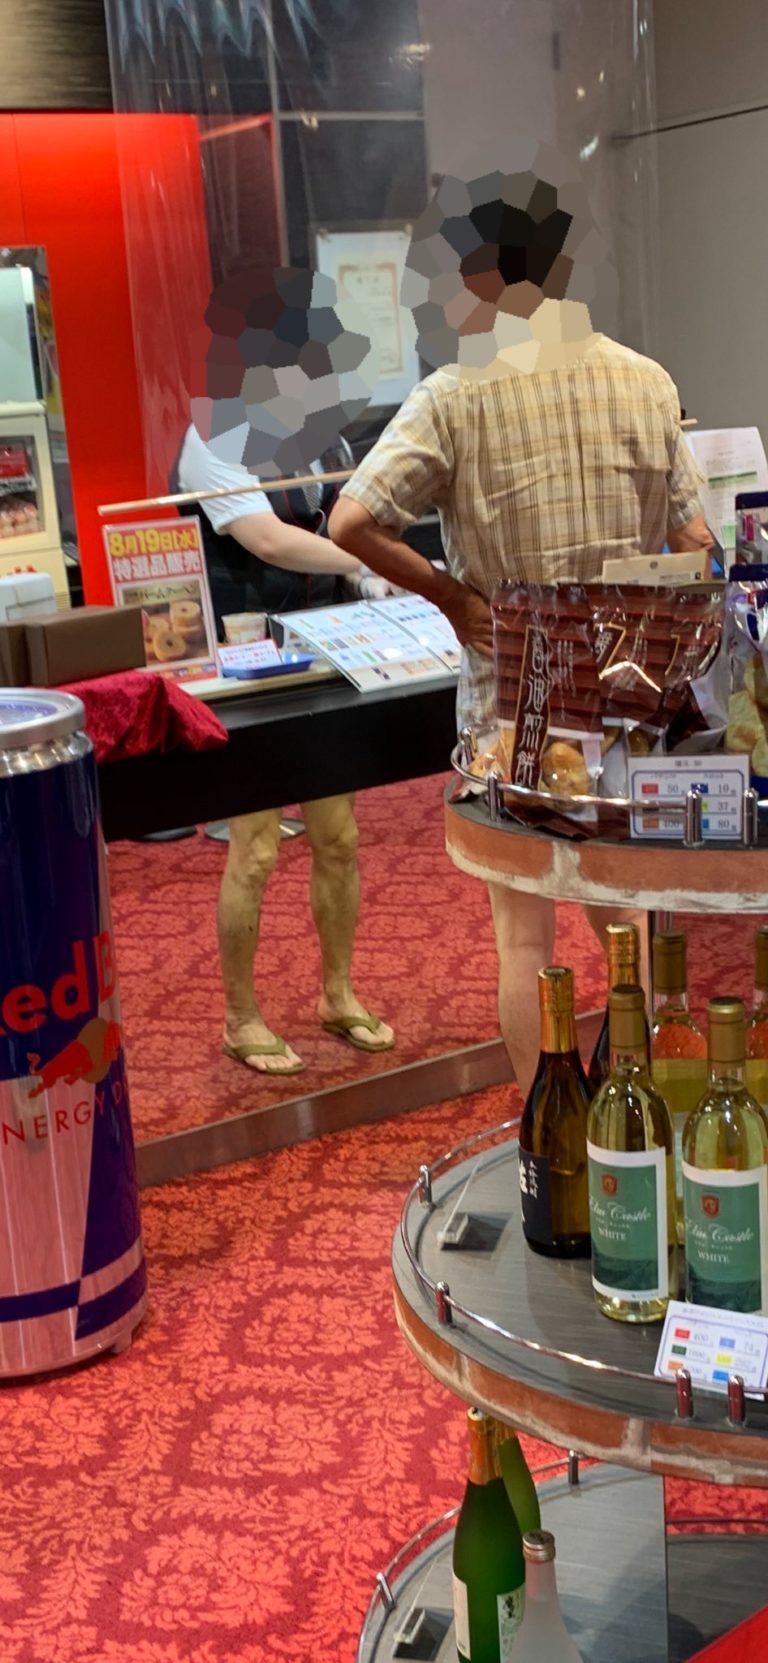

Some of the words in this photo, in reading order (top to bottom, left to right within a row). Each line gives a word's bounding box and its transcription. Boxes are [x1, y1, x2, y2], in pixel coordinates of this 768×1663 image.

[112, 550, 202, 582] 特選品販売
[0, 939, 90, 1035] ed
[598, 1226, 627, 1241] WHITE
[697, 1249, 730, 1264] WHITE
